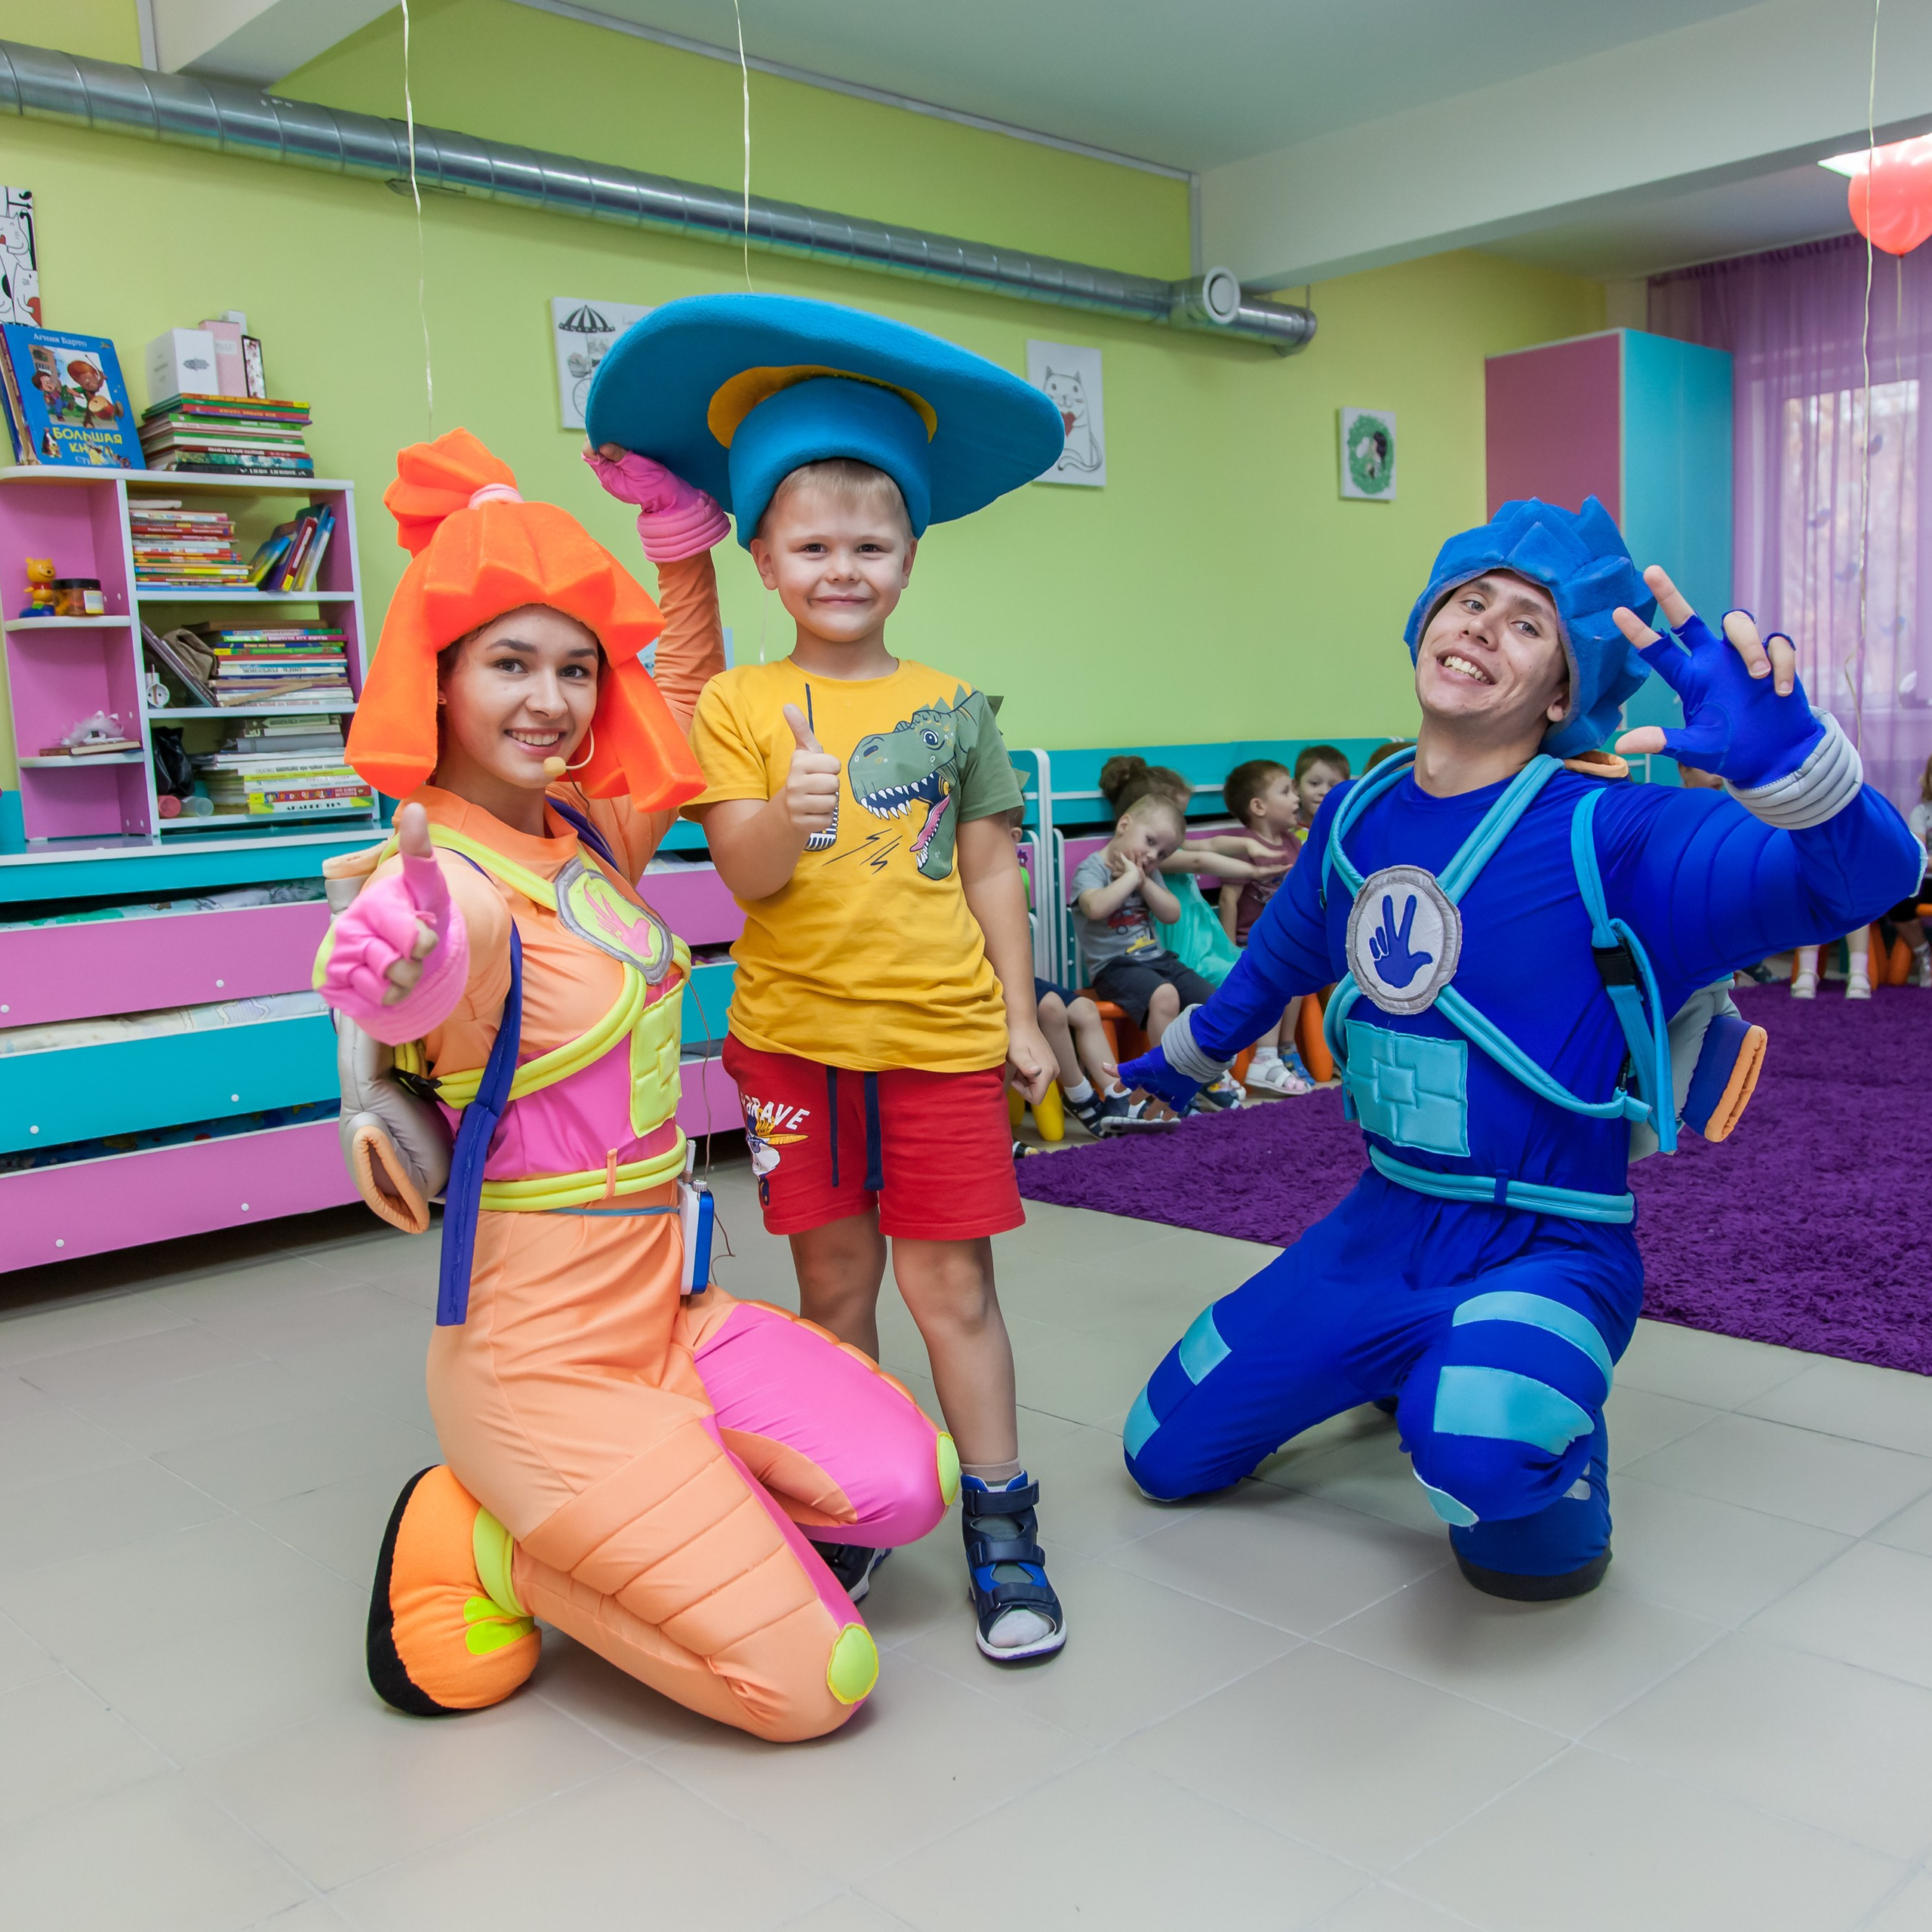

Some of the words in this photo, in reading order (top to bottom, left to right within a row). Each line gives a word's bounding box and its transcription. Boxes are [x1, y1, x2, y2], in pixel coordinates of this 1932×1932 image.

[34, 333, 60, 343] Агния
[60, 337, 88, 347] Барто
[52, 426, 123, 445] БОЛЬШАЯ
[69, 442, 114, 455] КНГА
[745, 1094, 811, 1131] BRAVE
